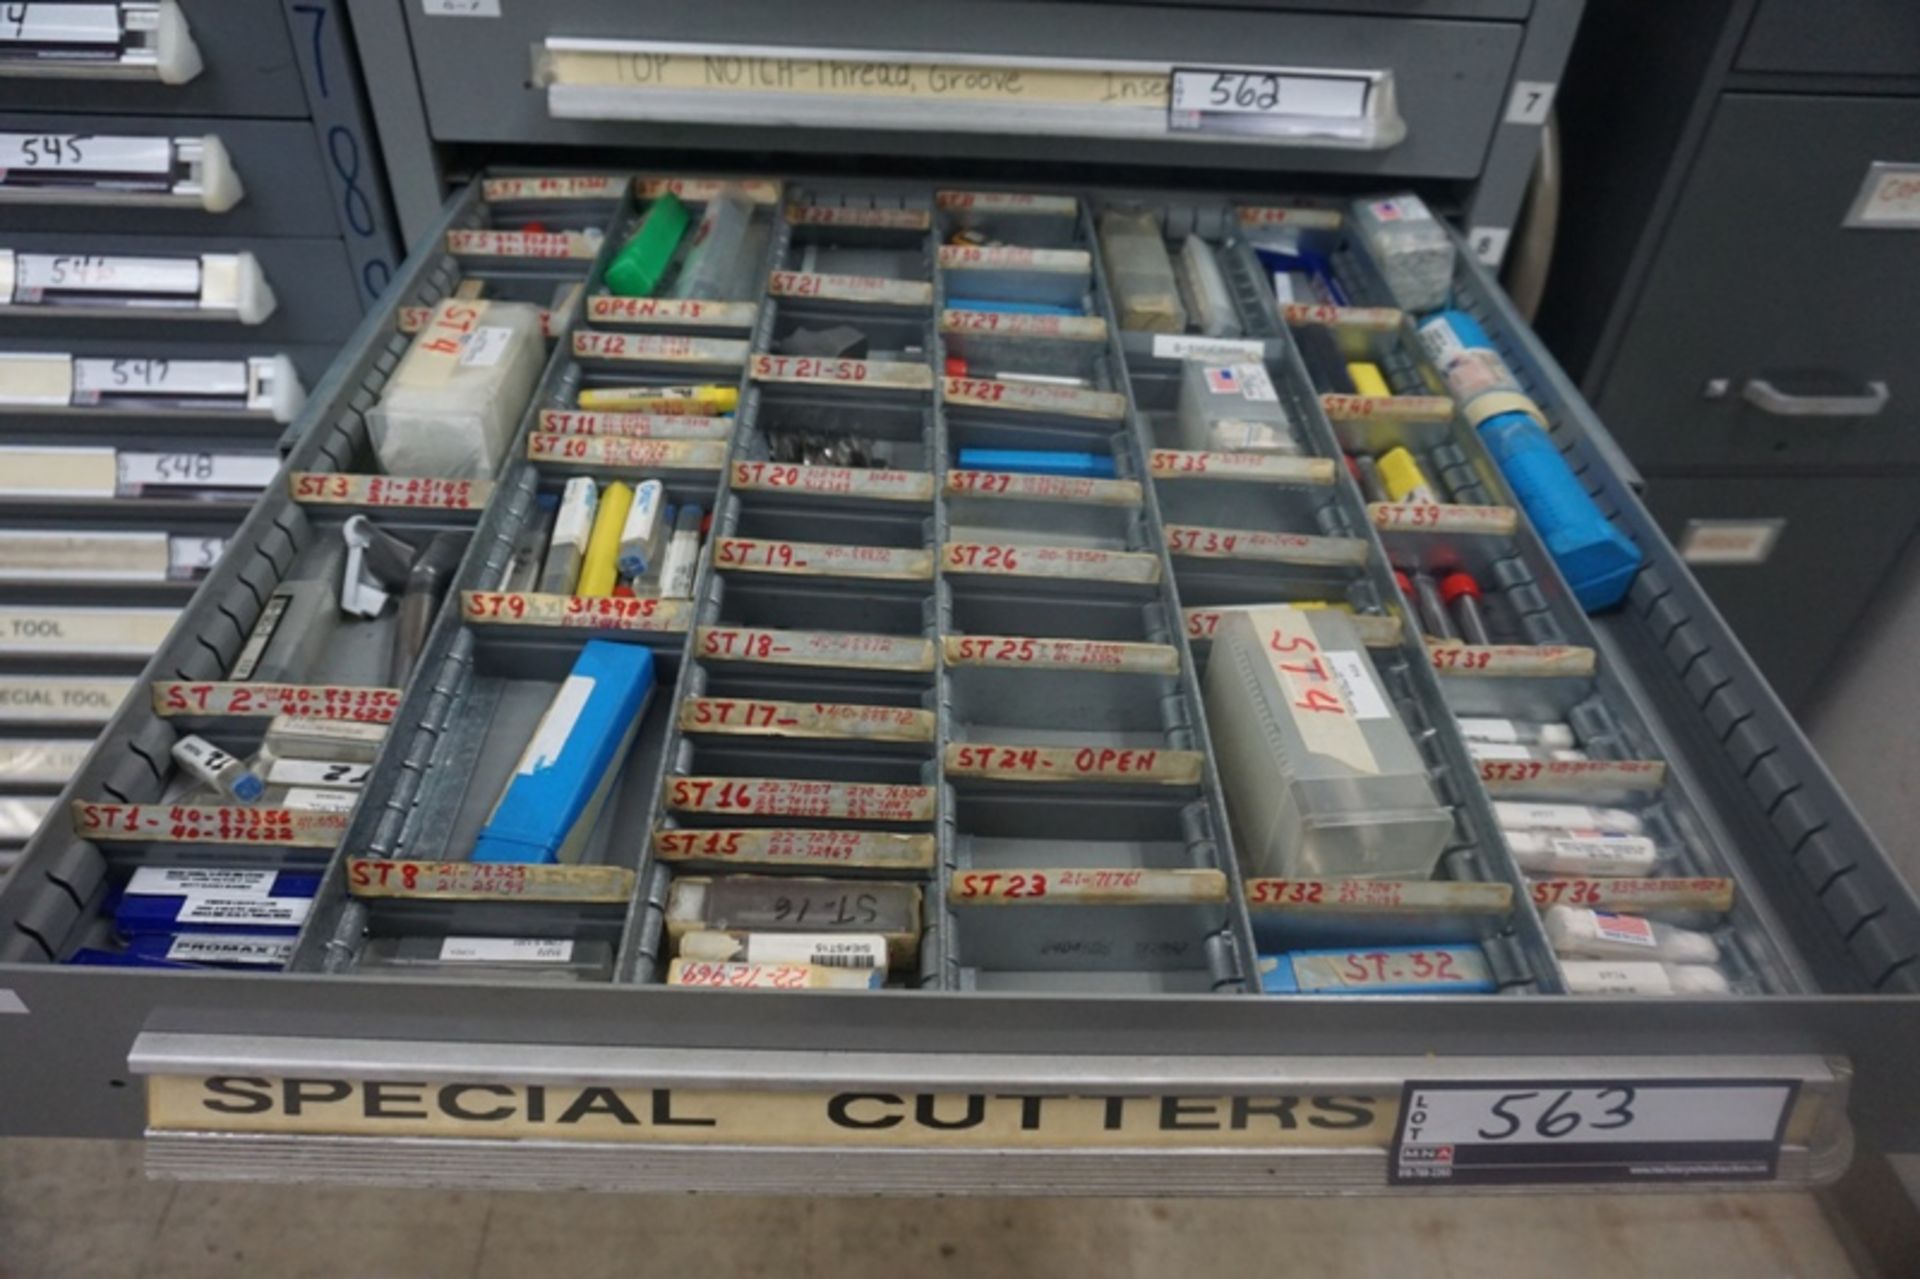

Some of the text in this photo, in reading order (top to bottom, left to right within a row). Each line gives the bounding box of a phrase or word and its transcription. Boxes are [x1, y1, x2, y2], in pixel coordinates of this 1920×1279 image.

[293, 5, 328, 97] 7
[616, 52, 669, 83] TOP
[1210, 75, 1280, 109] 562
[1525, 92, 1542, 113] 7
[22, 136, 93, 165] 545
[328, 126, 375, 237] 8
[594, 301, 656, 317] OPEN
[112, 360, 168, 384] 547
[155, 455, 212, 479] 548
[12, 620, 64, 637] TOOL
[62, 690, 111, 707] TOOL
[1075, 749, 1156, 771] OPEN
[203, 1076, 1376, 1131] SPECIAL CUTTERS
[1409, 1095, 1427, 1140] LOT
[1477, 1087, 1636, 1140] 563
